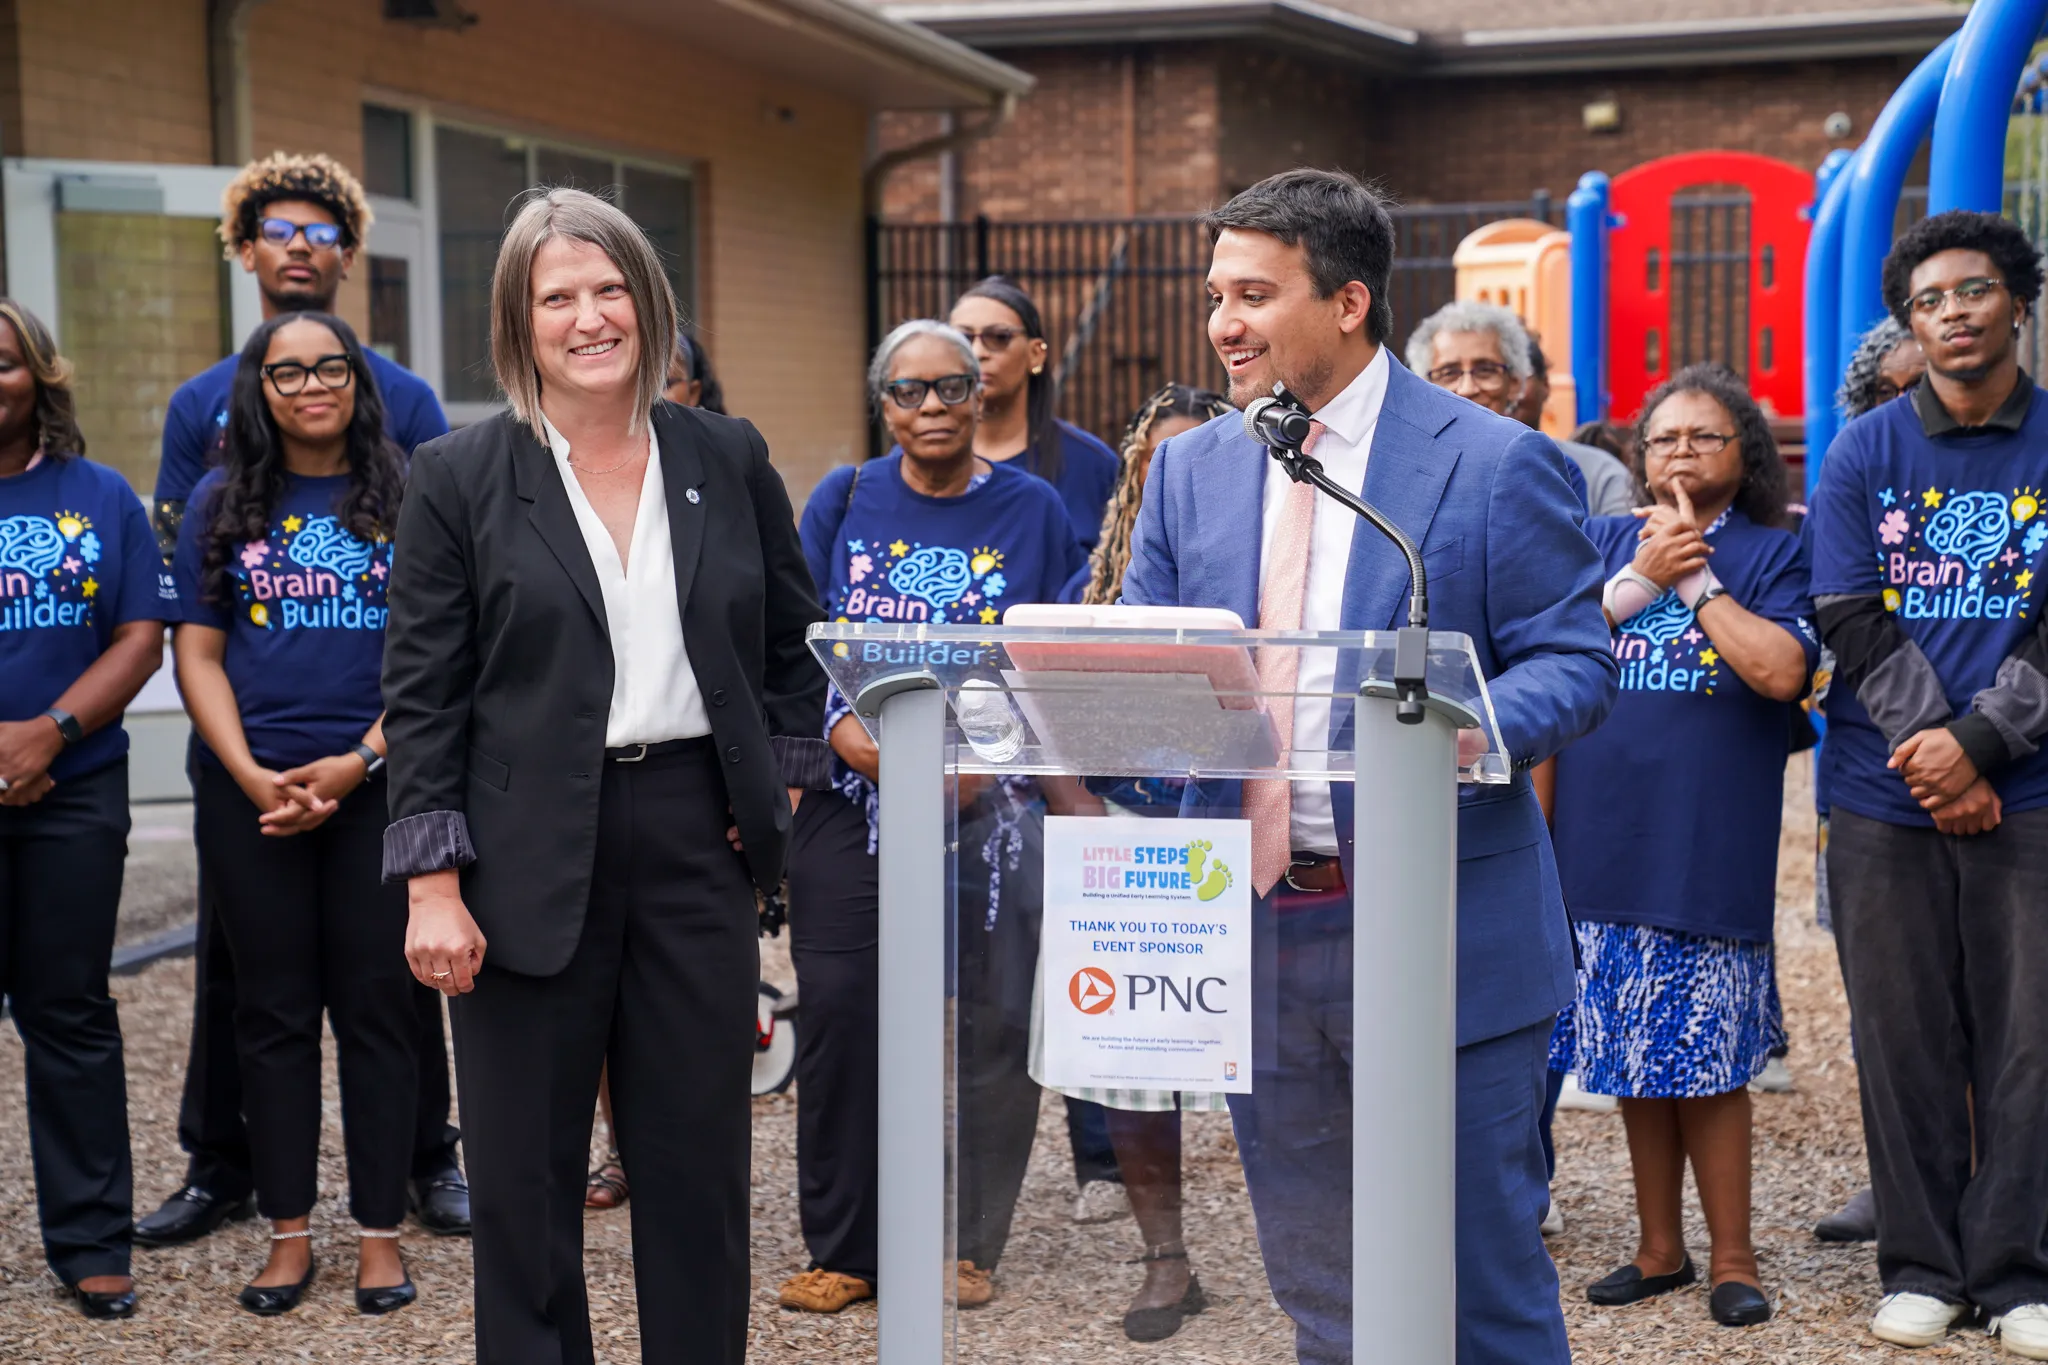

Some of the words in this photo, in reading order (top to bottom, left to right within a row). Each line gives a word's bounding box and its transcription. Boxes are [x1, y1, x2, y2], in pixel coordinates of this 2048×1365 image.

[250, 567, 338, 600] Brain
[1890, 552, 1964, 586] Brain
[0, 594, 87, 631] uilder
[281, 597, 389, 629] Builder
[846, 588, 928, 620] Brain
[1904, 586, 2020, 619] Builder
[862, 642, 986, 665] Builder
[1083, 847, 1132, 862] LITTLE
[1134, 847, 1189, 865] STEPS
[1083, 866, 1121, 889] BIG
[1125, 871, 1191, 889] FUTURE
[1069, 920, 1116, 932] THANK
[1119, 921, 1147, 933] YOU
[1150, 922, 1168, 934] TO
[1171, 923, 1227, 935] TODAY'S
[1093, 941, 1136, 952] EVENT
[1139, 942, 1203, 954] SPONSOR
[1123, 974, 1228, 1014] PNC
